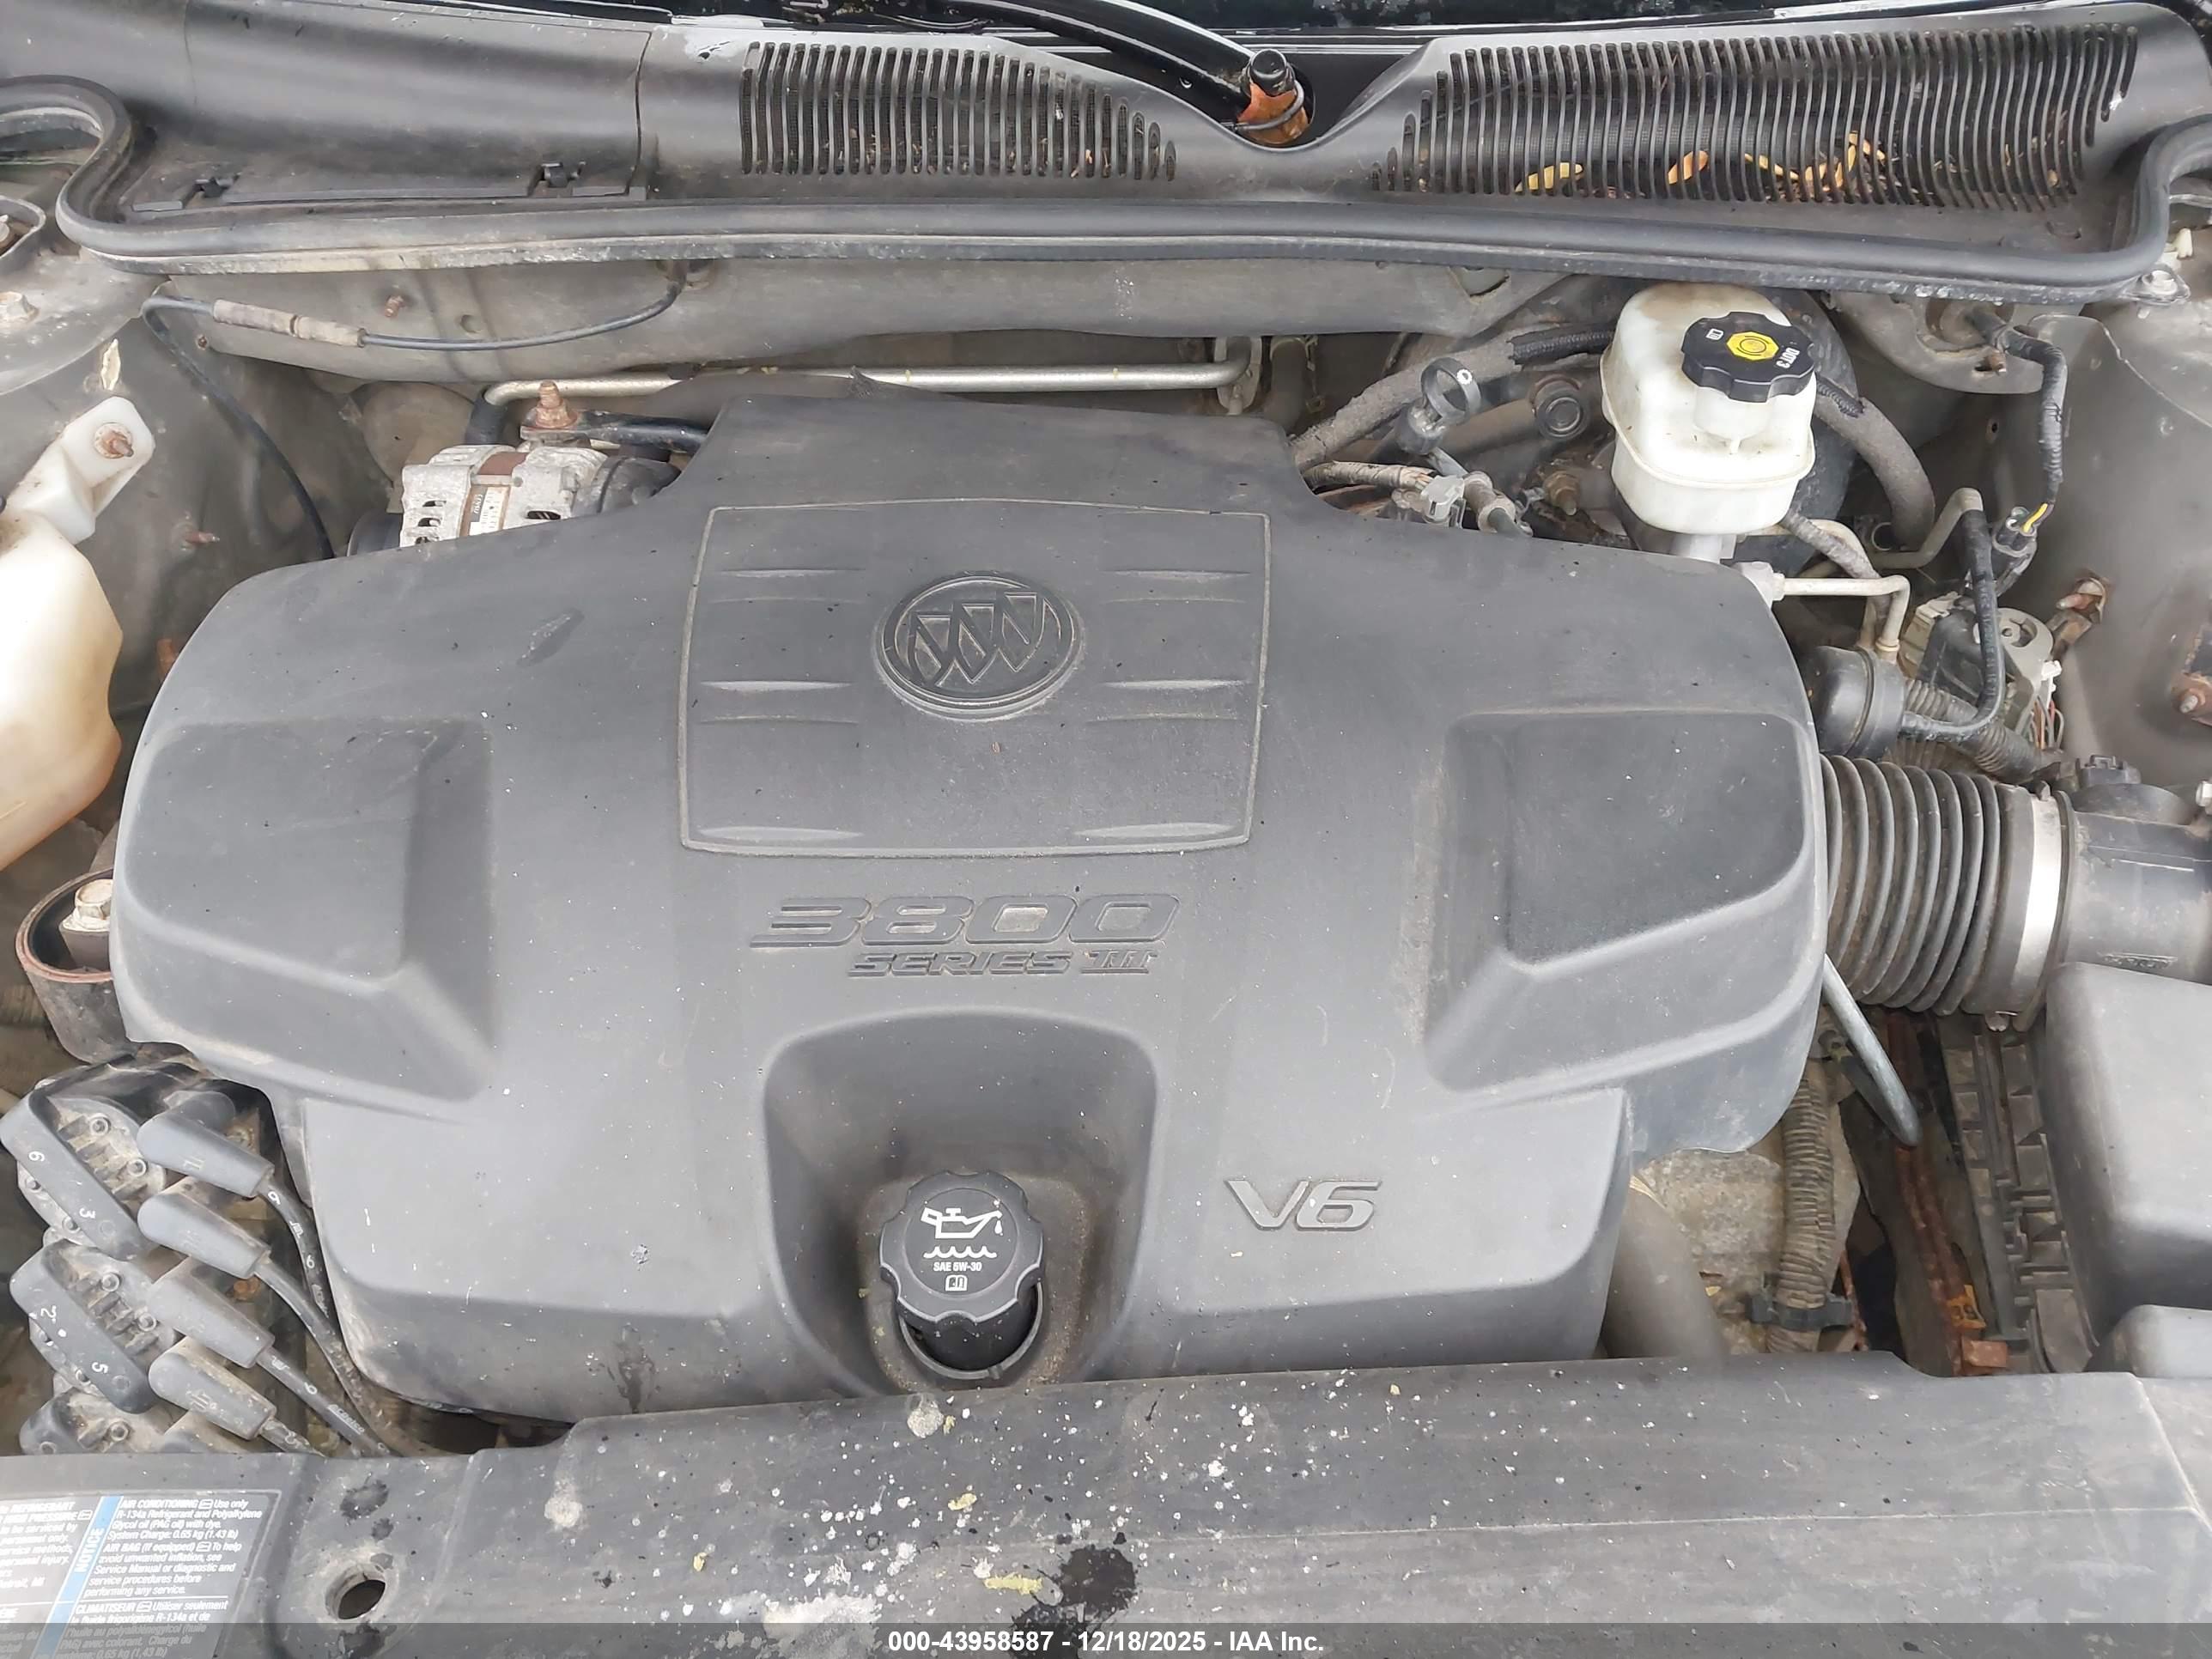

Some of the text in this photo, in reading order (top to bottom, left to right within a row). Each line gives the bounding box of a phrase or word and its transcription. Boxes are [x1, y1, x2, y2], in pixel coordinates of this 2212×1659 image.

[1776, 347, 1801, 368] DOT 3
[750, 894, 1180, 947] 3800
[848, 951, 1158, 977] SERIES III
[1224, 1180, 1381, 1231] V6
[79, 1207, 96, 1218] 3
[933, 1261, 982, 1272] SAE 5W-30
[92, 1362, 108, 1374] 5
[137, 1499, 198, 1509] CONDITIONING
[214, 1499, 228, 1508] Use
[230, 1499, 249, 1509] only
[117, 1510, 146, 1519] R-134a
[147, 1510, 193, 1520] Refrigerant
[194, 1510, 210, 1518] and
[112, 1519, 222, 1530] Glycol oil (PAG oil) with dye.
[107, 1531, 139, 1542] System
[172, 1530, 191, 1540] 0.65
[192, 1530, 204, 1540] kg
[204, 1530, 227, 1540] (1.43
[228, 1530, 239, 1540] lb)
[74, 1528, 104, 1572] NOTICE
[103, 1543, 119, 1553] AIR
[121, 1543, 141, 1552] BAG
[152, 1542, 195, 1553] equipped)
[213, 1542, 223, 1551] To
[223, 1542, 242, 1553] help
[99, 1554, 124, 1564] avoid
[125, 1553, 167, 1563] unwanted
[94, 1565, 127, 1575] Service
[129, 1565, 161, 1573] Manual
[173, 1564, 217, 1575] diagnostic
[218, 1563, 236, 1572] and
[88, 1575, 203, 1587] service procedures before
[85, 1585, 185, 1597] performing any service.
[76, 1600, 228, 1614] CLIMATISEUR Utiliser seulement
[155, 1612, 186, 1622] R-134a
[188, 1613, 198, 1621] et
[198, 1612, 210, 1621] de
[149, 1635, 179, 1647] Charge
[181, 1635, 192, 1644] du
